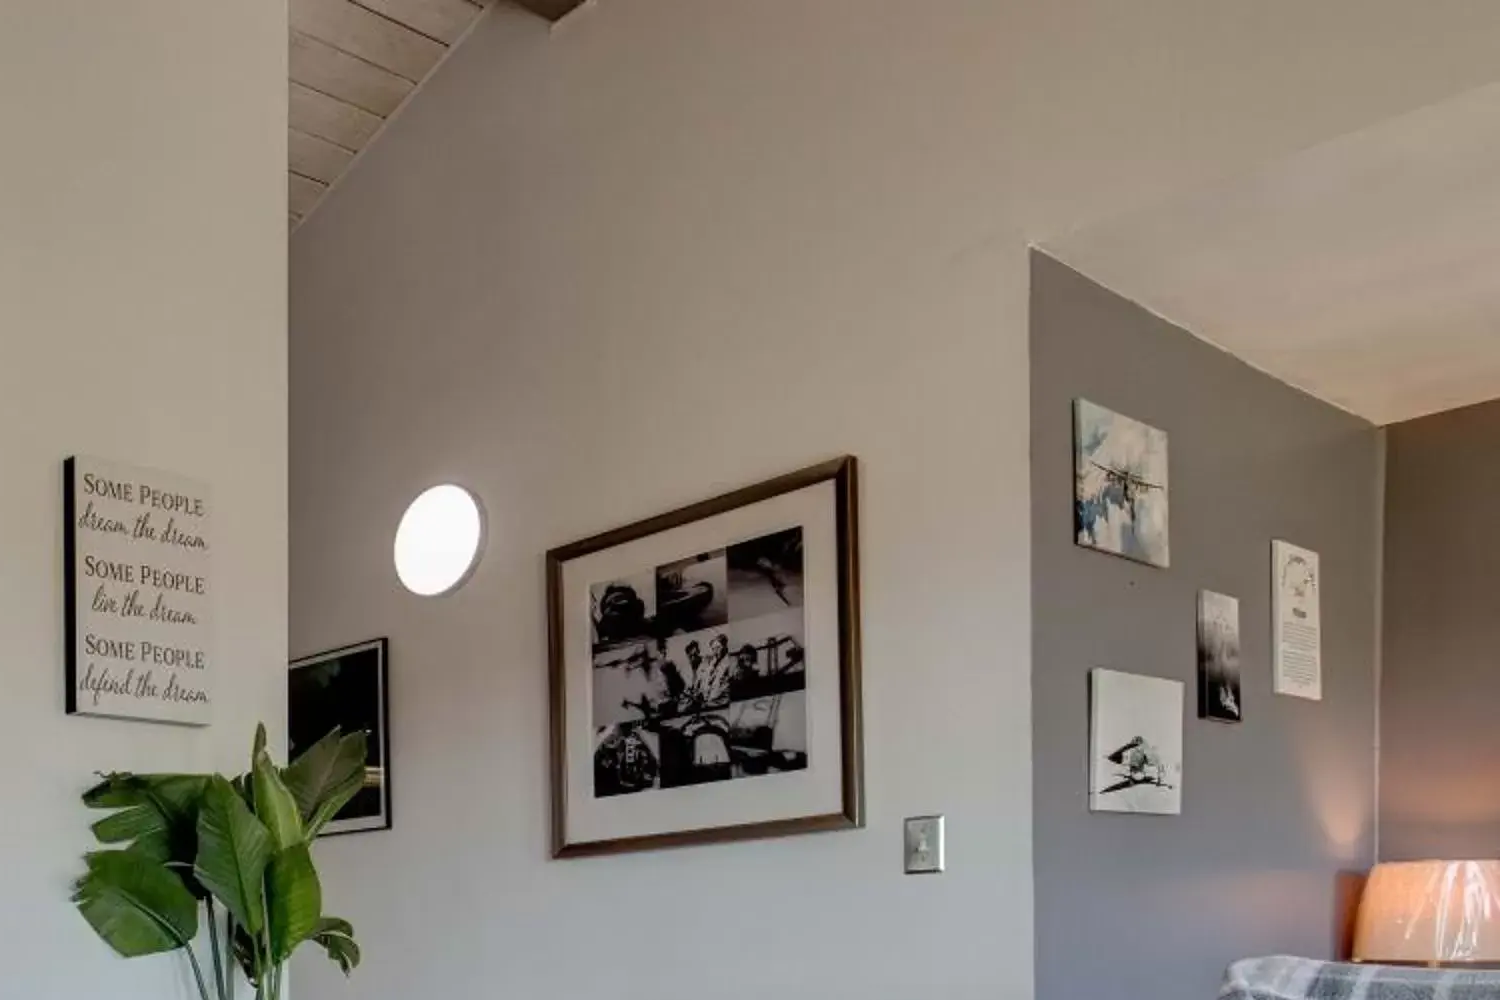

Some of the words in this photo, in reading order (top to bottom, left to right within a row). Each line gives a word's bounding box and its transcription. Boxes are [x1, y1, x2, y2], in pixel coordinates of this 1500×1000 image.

[83, 473, 133, 503] SOME
[139, 485, 204, 517] PEOPLE
[78, 500, 130, 536] dream
[132, 511, 158, 540] the
[160, 517, 209, 551] dream
[84, 555, 135, 583] SOME
[140, 564, 205, 595] PEOPLE
[91, 583, 119, 613] live
[121, 589, 147, 617] the
[149, 592, 197, 625] dream
[85, 633, 135, 661] SOME
[140, 641, 204, 670] PEOPLE
[79, 662, 135, 706] defend
[135, 669, 159, 698] the
[162, 672, 209, 703] dream
